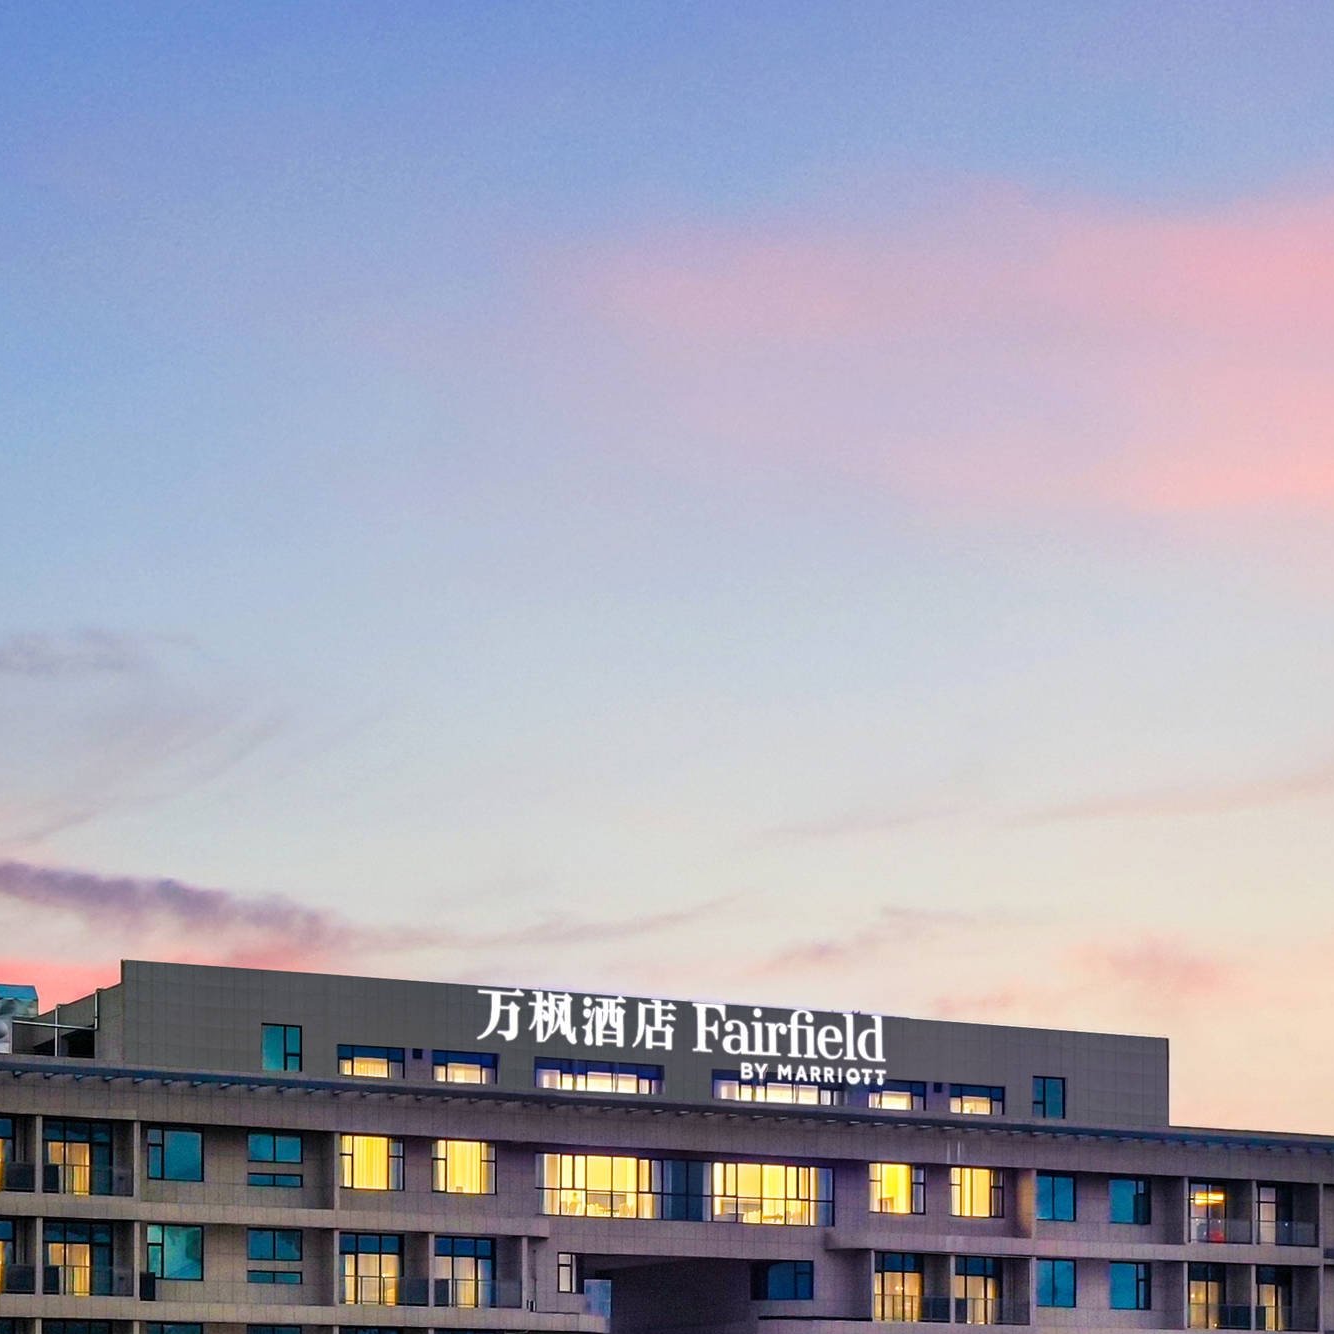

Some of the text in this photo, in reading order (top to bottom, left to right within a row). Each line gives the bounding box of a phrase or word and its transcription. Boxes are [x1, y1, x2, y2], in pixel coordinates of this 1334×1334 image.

[477, 989, 886, 1062] 万枫酒店 Fairfield
[740, 1062, 887, 1085] BY MARRIOTT
